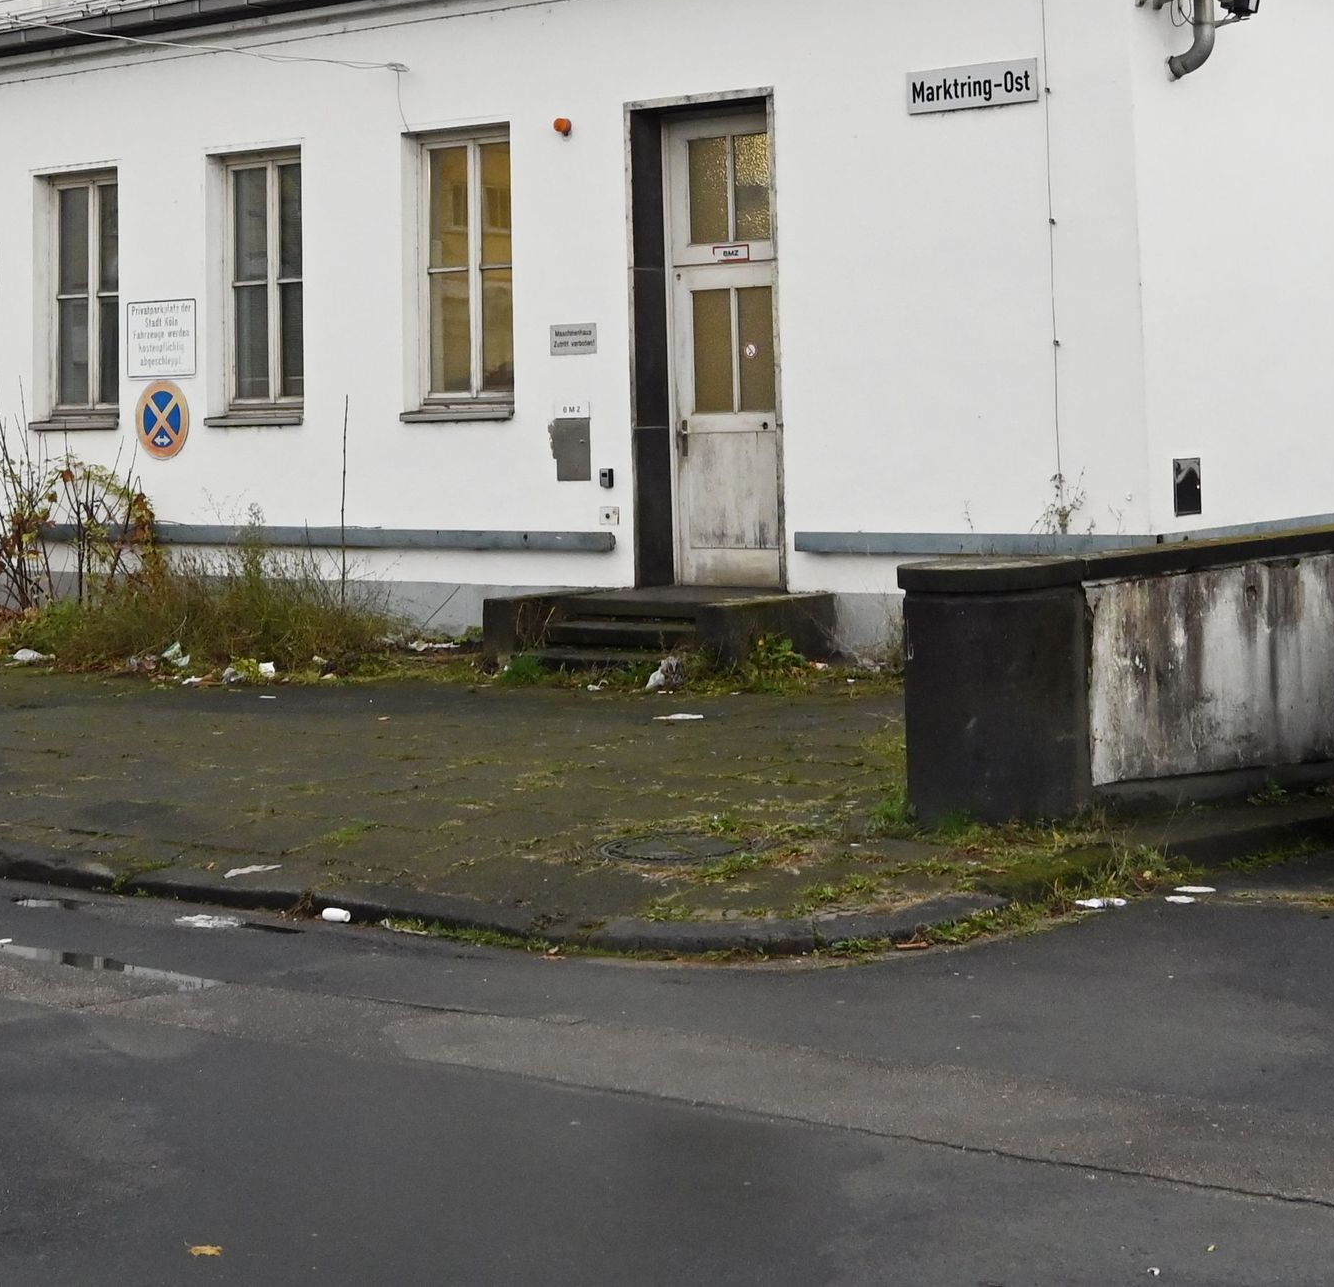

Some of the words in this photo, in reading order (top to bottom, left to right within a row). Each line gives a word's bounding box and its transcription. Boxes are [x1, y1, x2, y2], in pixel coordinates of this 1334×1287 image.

[912, 70, 1031, 104] Marktring-Ost
[131, 303, 179, 316] Privatparkplatz
[181, 302, 191, 313] der
[145, 317, 162, 328] Stadt
[164, 316, 178, 327] Köln
[133, 330, 165, 341] Fahrzeuge
[167, 327, 190, 338] werden
